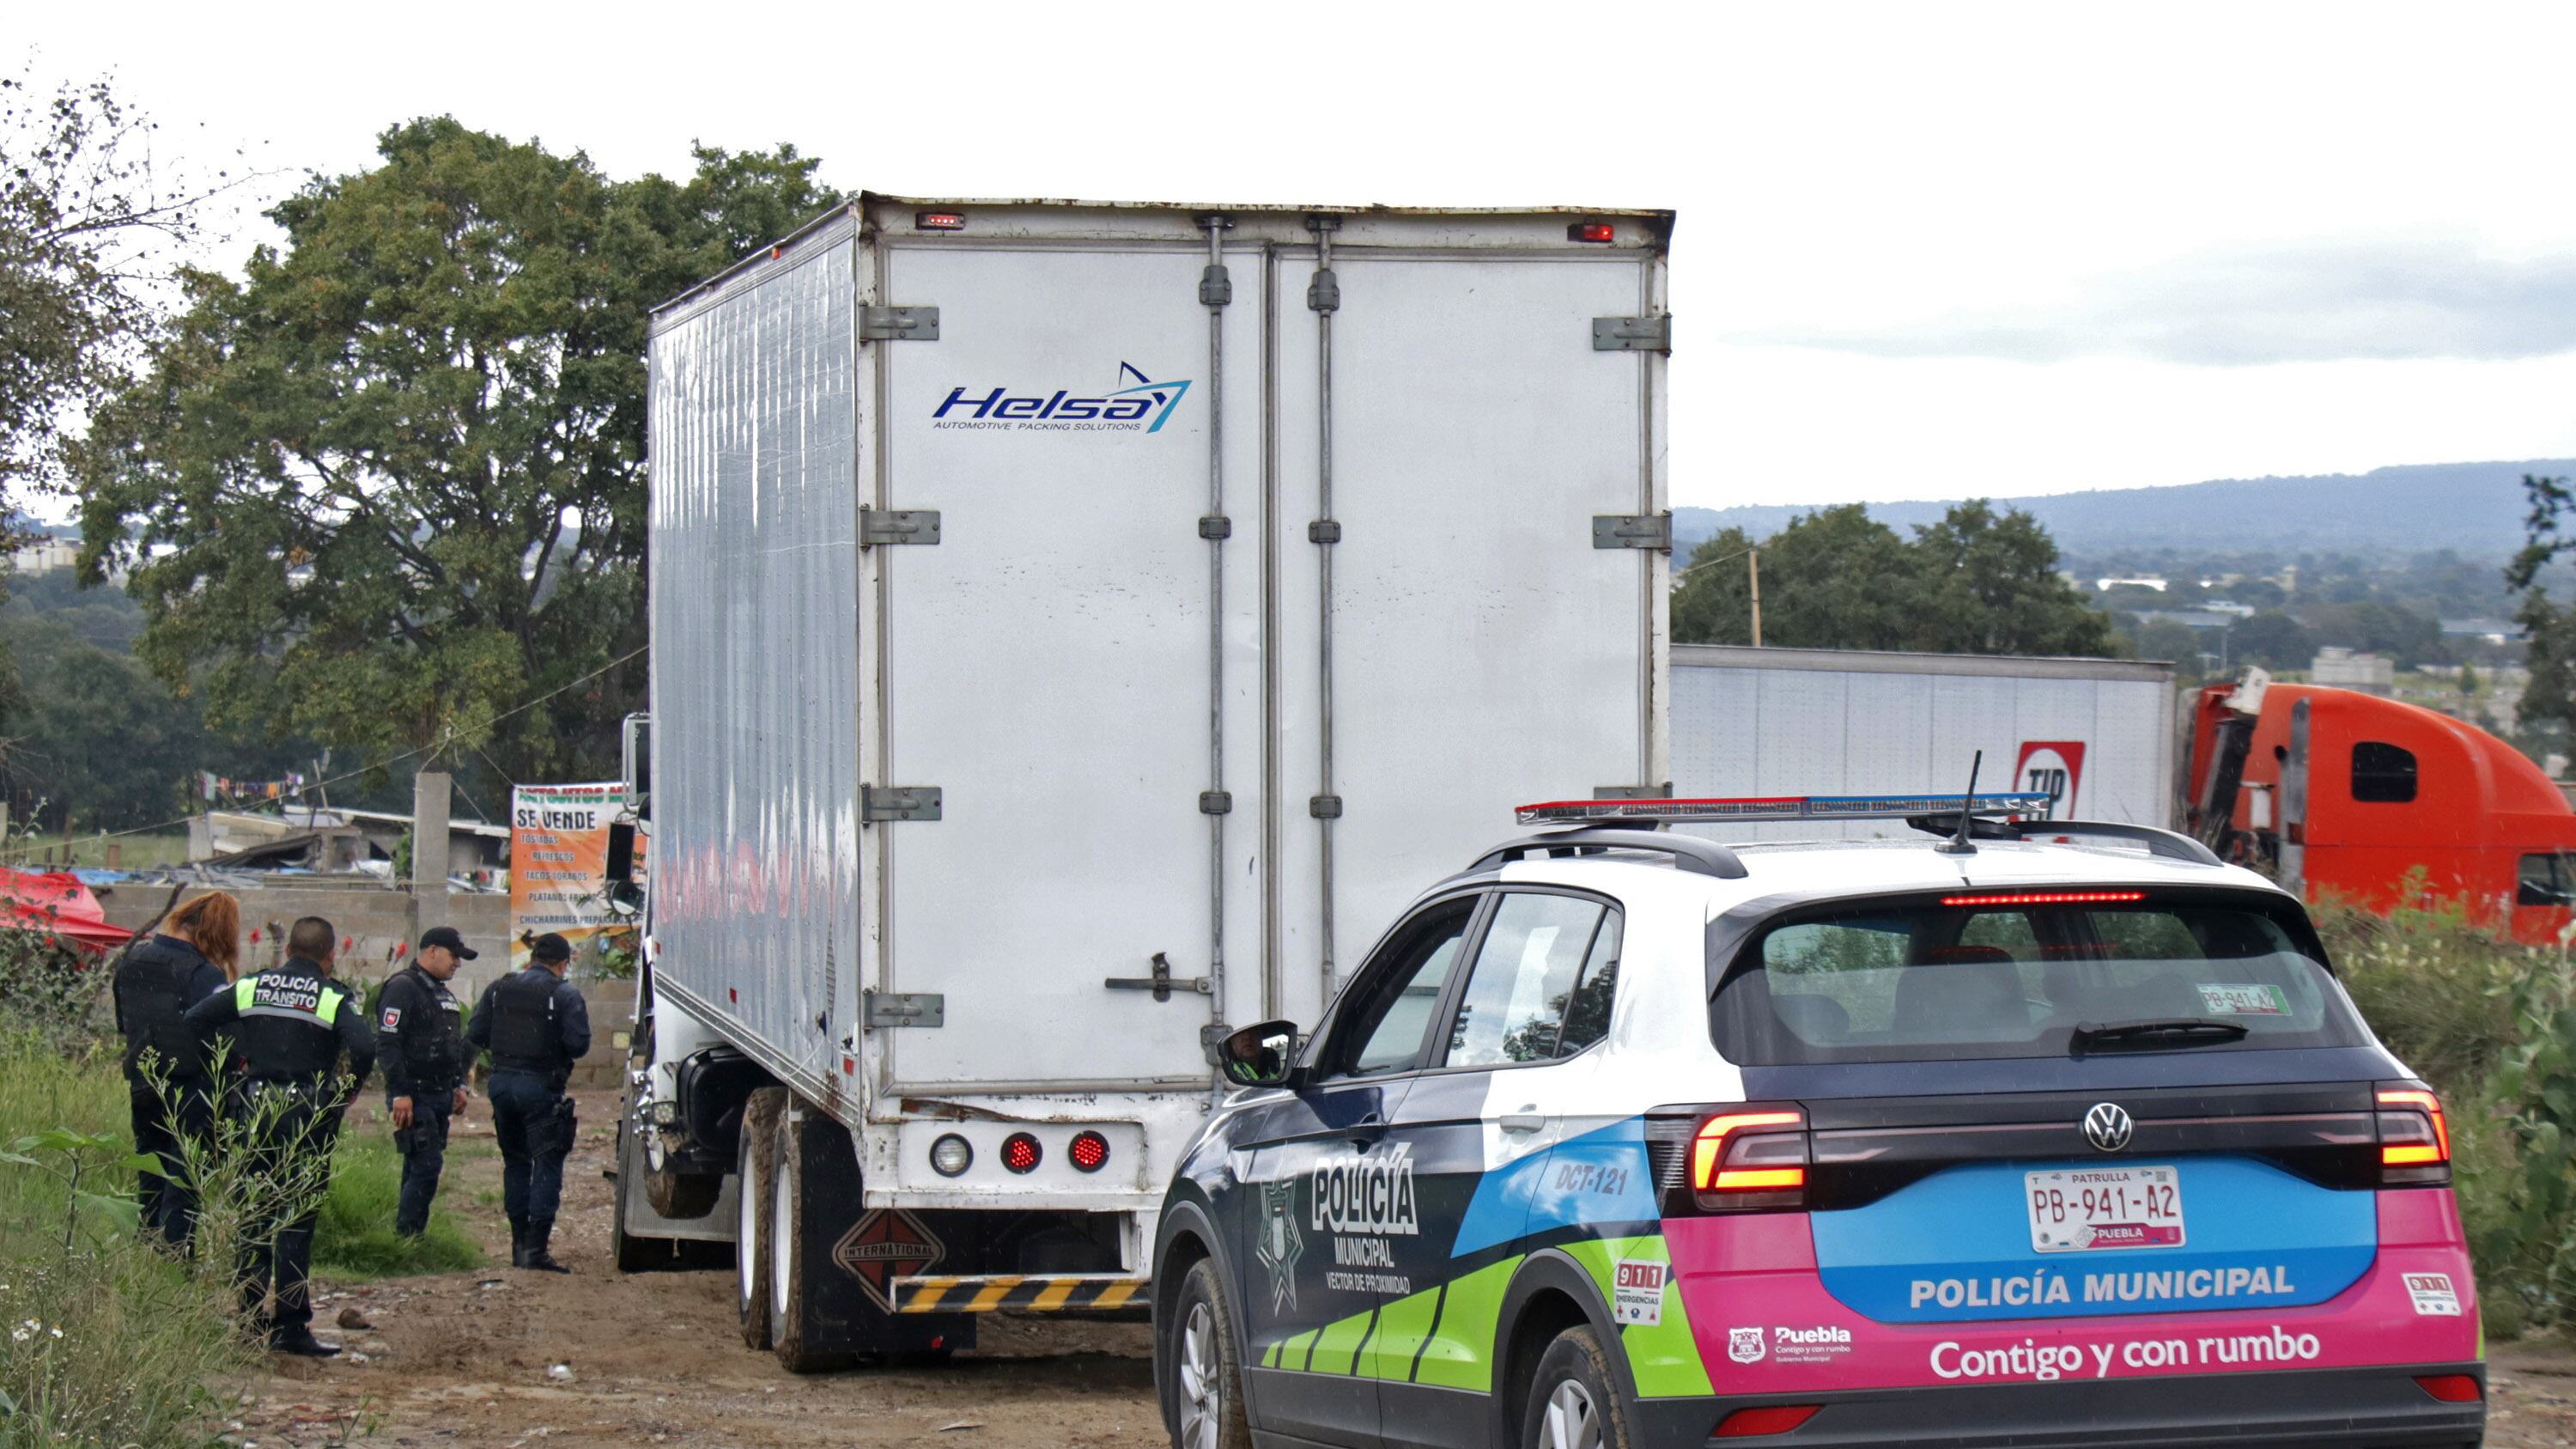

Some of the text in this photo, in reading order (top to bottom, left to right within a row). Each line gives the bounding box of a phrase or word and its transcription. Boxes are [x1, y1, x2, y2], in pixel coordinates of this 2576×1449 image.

[933, 387, 1152, 420] Helsa
[933, 421, 1140, 431] AUTOMOTIVE PACKING SOLUTIONS
[517, 809, 596, 830] SE VENDE
[526, 872, 550, 881] TACOS
[519, 916, 577, 925] CHICHARRINES
[258, 975, 319, 994] POLICÍA
[255, 987, 317, 1008] TRÁNSITO
[1555, 1164, 1628, 1196] DCT-121
[2072, 1172, 2130, 1184] PATRULLA
[1312, 1142, 1419, 1235] POLICÍA
[2033, 1185, 2177, 1224] PB-941-A2
[2098, 1227, 2144, 1239] PUEBLA
[844, 1245, 933, 1257] INTERNATIONAL
[1334, 1237, 1394, 1268] MUNICIPAL
[1326, 1272, 1411, 1294] VECTOR DE PROXIMIDAD
[1619, 1265, 1659, 1287] 911
[2411, 1278, 2447, 1289] 911
[1911, 1266, 2294, 1308] POLICÍA MUNICIPAL
[1616, 1294, 1659, 1305] EMERGENCIAS
[1775, 1326, 1851, 1343] Puebla
[1775, 1346, 1805, 1355] Contigo
[1929, 1325, 2320, 1381] Contigo y con rumbo
